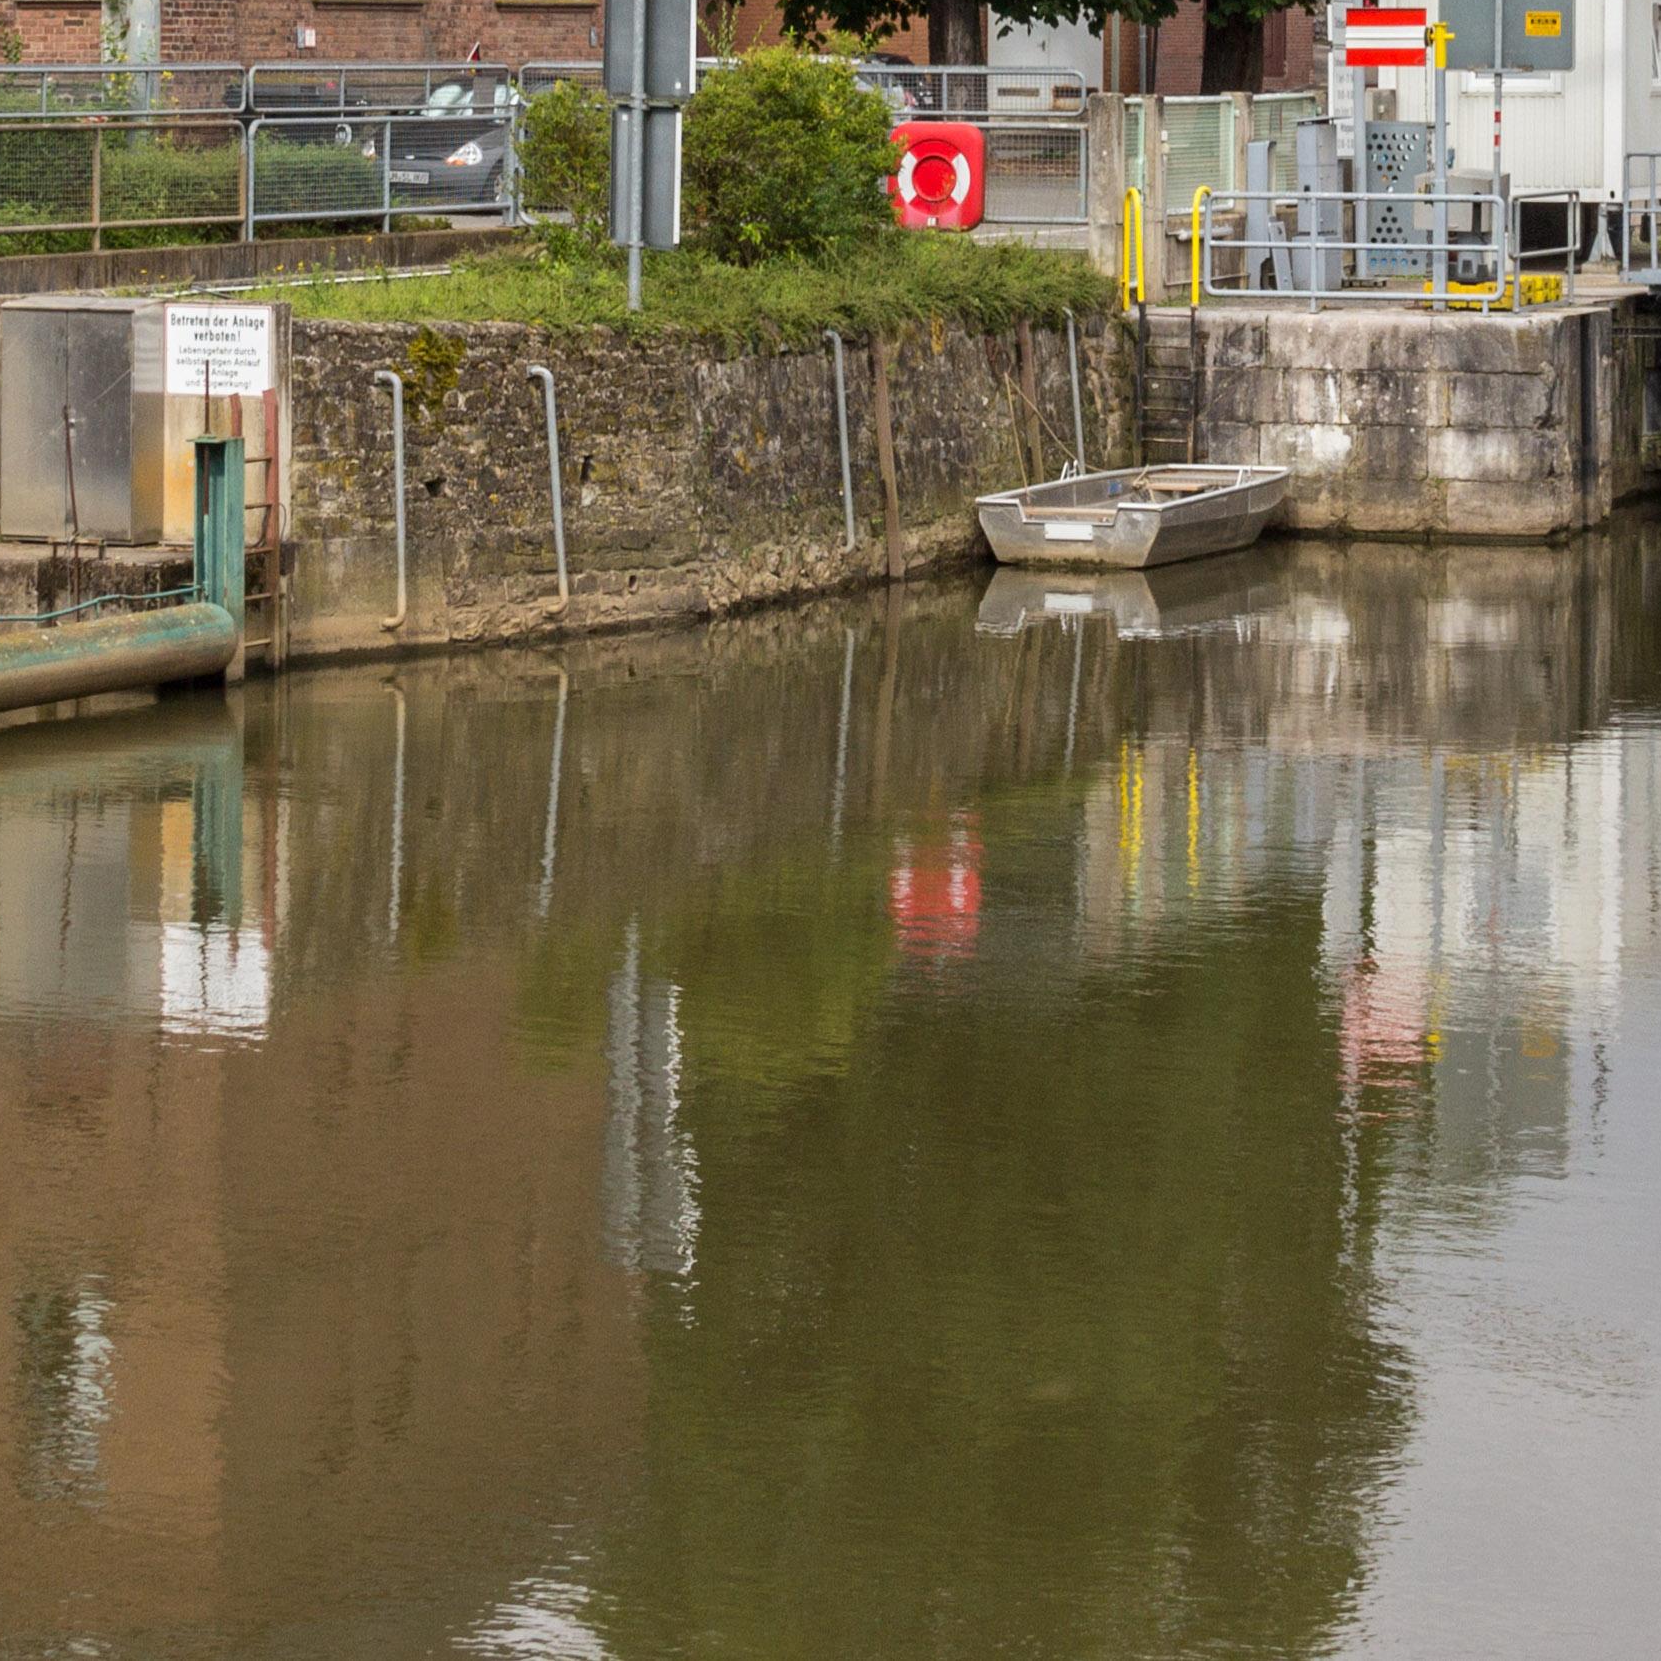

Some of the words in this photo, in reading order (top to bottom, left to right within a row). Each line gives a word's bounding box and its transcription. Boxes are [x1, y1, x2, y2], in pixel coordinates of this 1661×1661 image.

[170, 313, 210, 326] Betreten
[212, 315, 228, 327] der
[232, 315, 265, 331] Anlage
[194, 330, 241, 342] verboten!
[179, 346, 232, 356] Lebensgefahr
[234, 347, 256, 356] durch
[234, 357, 261, 367] Anlauf
[195, 368, 208, 376] de
[211, 368, 238, 378] Anlage
